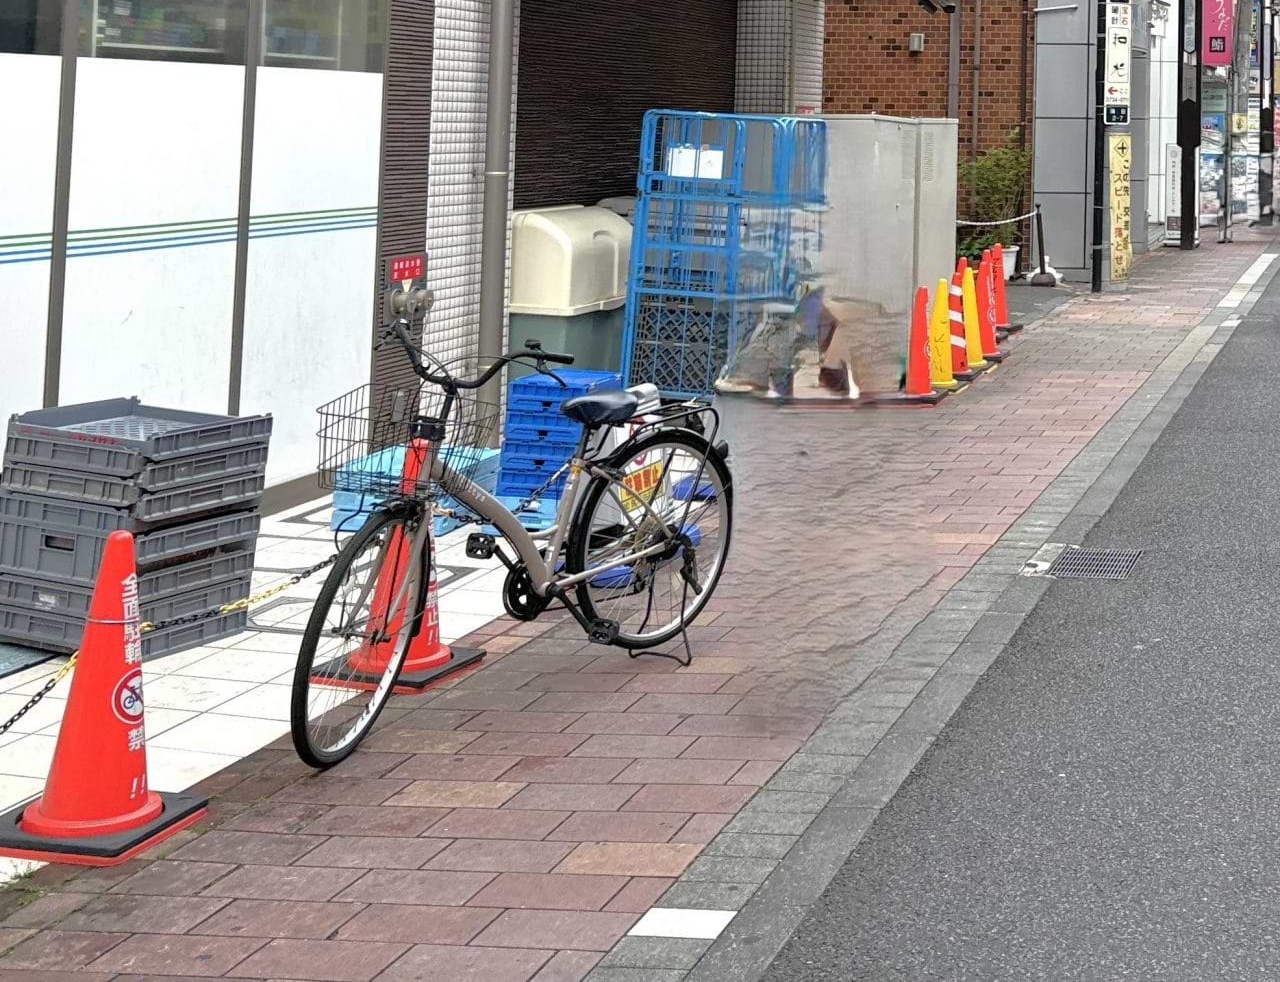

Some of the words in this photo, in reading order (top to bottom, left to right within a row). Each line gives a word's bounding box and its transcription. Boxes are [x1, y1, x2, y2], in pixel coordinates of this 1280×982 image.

[1114, 173, 1123, 265] スピード落とせ
